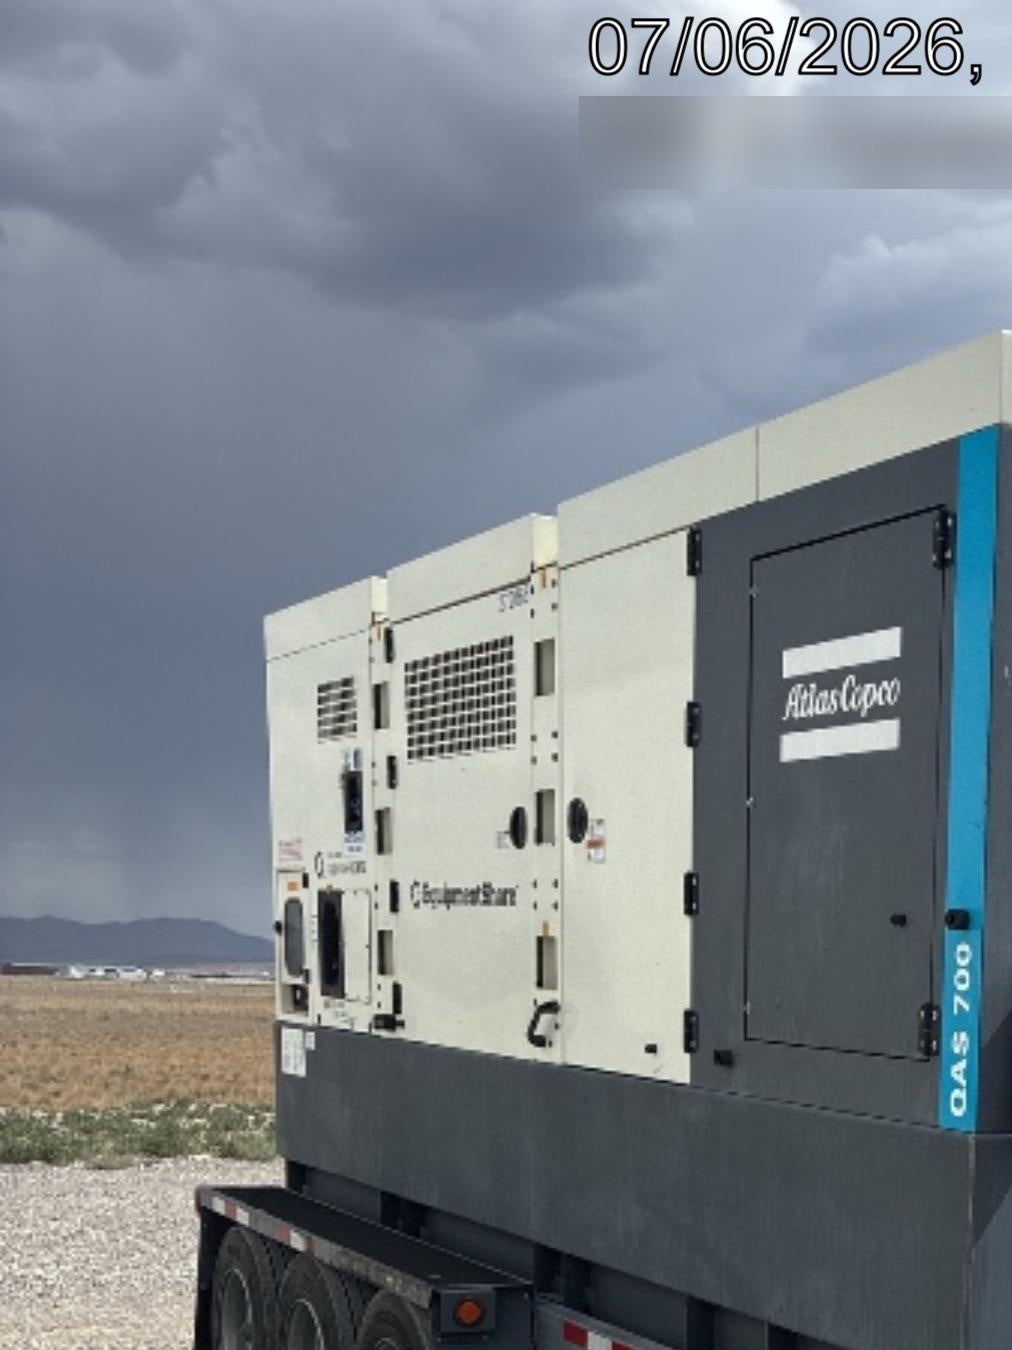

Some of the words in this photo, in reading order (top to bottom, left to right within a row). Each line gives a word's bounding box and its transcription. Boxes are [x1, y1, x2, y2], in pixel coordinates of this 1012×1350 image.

[781, 682, 838, 721] Atlas
[839, 673, 901, 718] Copco
[952, 942, 973, 1016] 700
[950, 1030, 970, 1118] QAS
